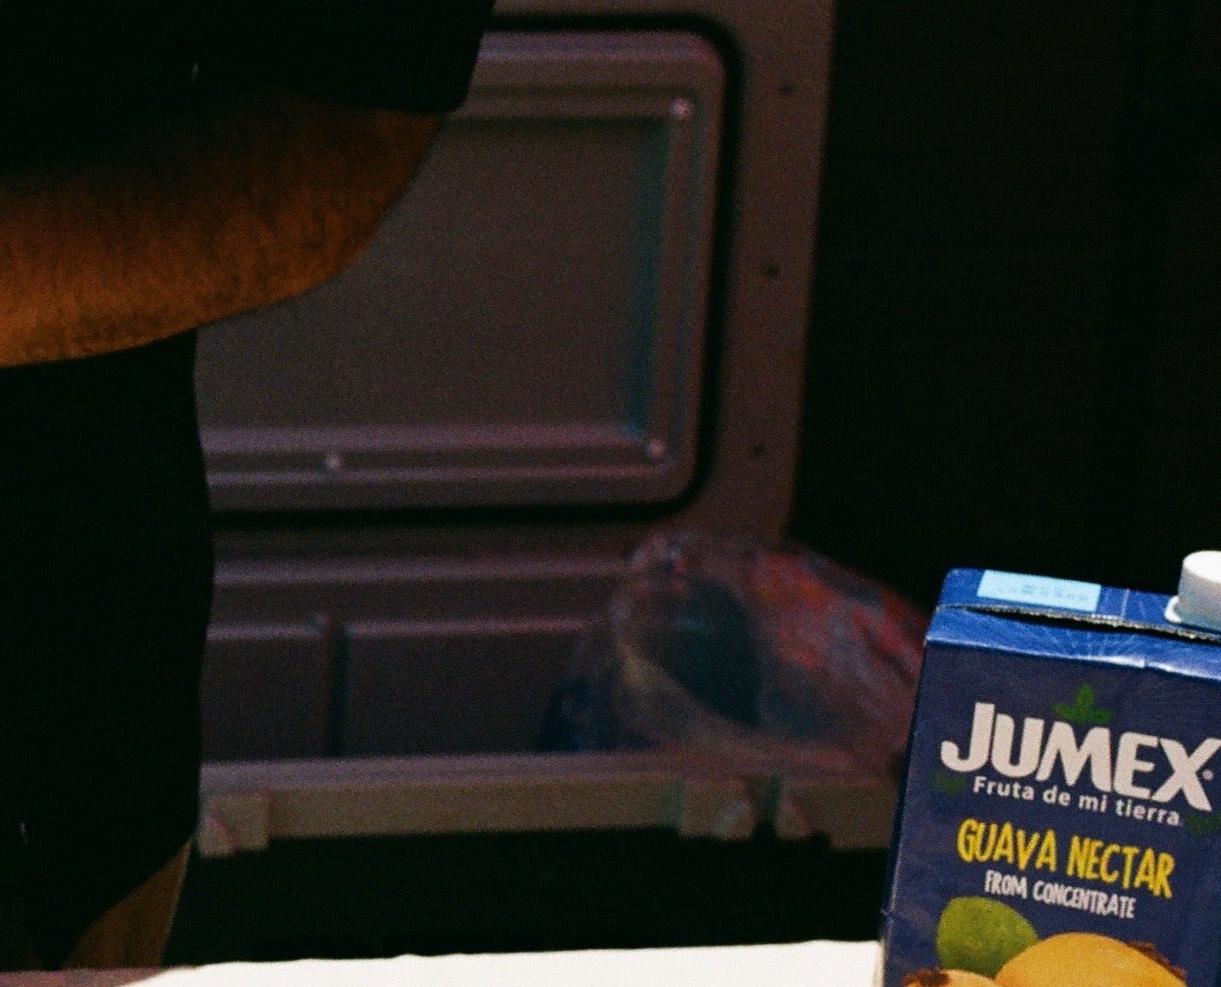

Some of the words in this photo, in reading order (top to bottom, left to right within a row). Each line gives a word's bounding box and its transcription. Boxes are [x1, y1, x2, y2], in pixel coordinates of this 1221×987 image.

[940, 702, 1221, 812] JUMEX
[972, 776, 1035, 801] Fruta
[1042, 785, 1071, 807] de
[1078, 794, 1107, 813] mi
[957, 818, 1057, 873] GUAVA
[1066, 835, 1175, 899] NECTAR
[984, 869, 1028, 899] FROM
[1033, 880, 1136, 919] CONCENTRATE
